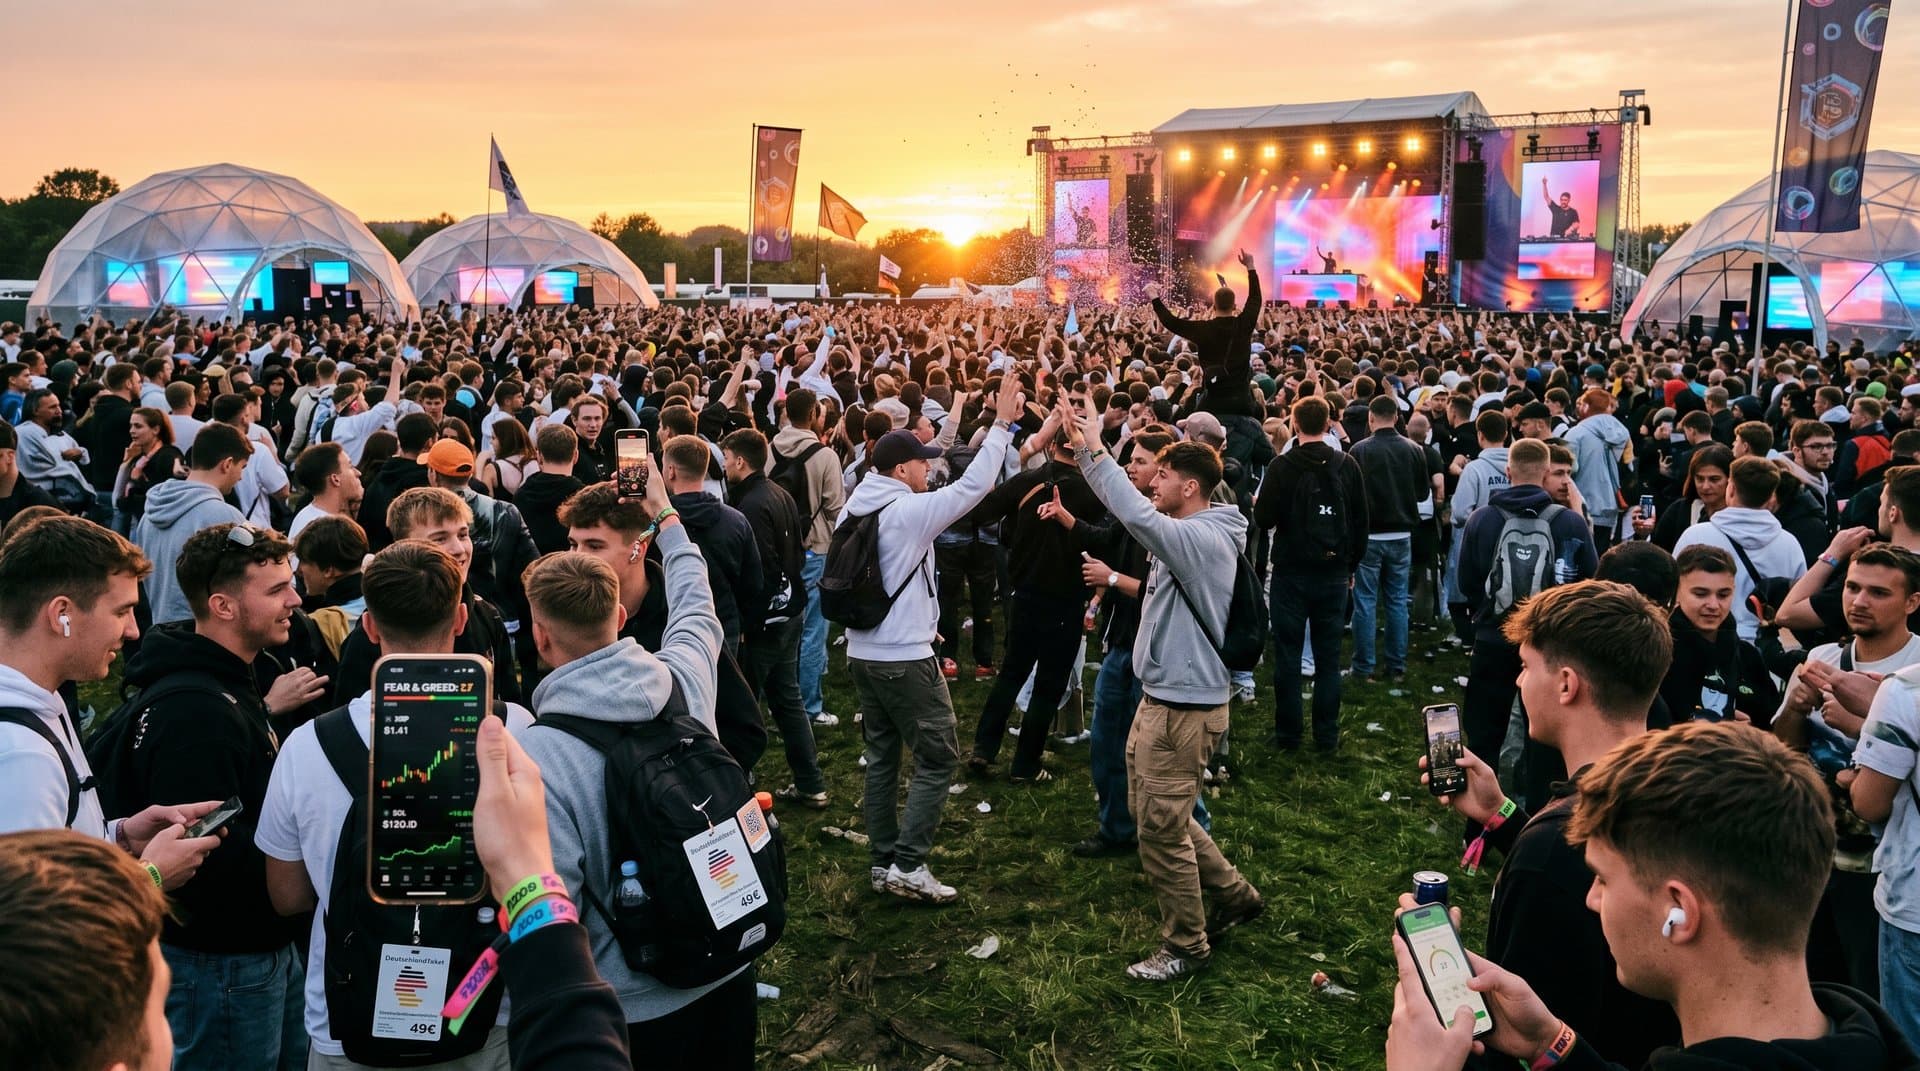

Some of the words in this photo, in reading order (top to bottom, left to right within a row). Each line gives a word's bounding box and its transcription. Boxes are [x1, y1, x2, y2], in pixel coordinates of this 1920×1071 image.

[384, 683, 410, 692] FEAR
[412, 683, 420, 692] &
[421, 683, 459, 692] GREED:
[384, 726, 408, 735] $1.41
[392, 809, 407, 817] SOL
[741, 889, 762, 907] 49€
[410, 1023, 436, 1035] 49€
